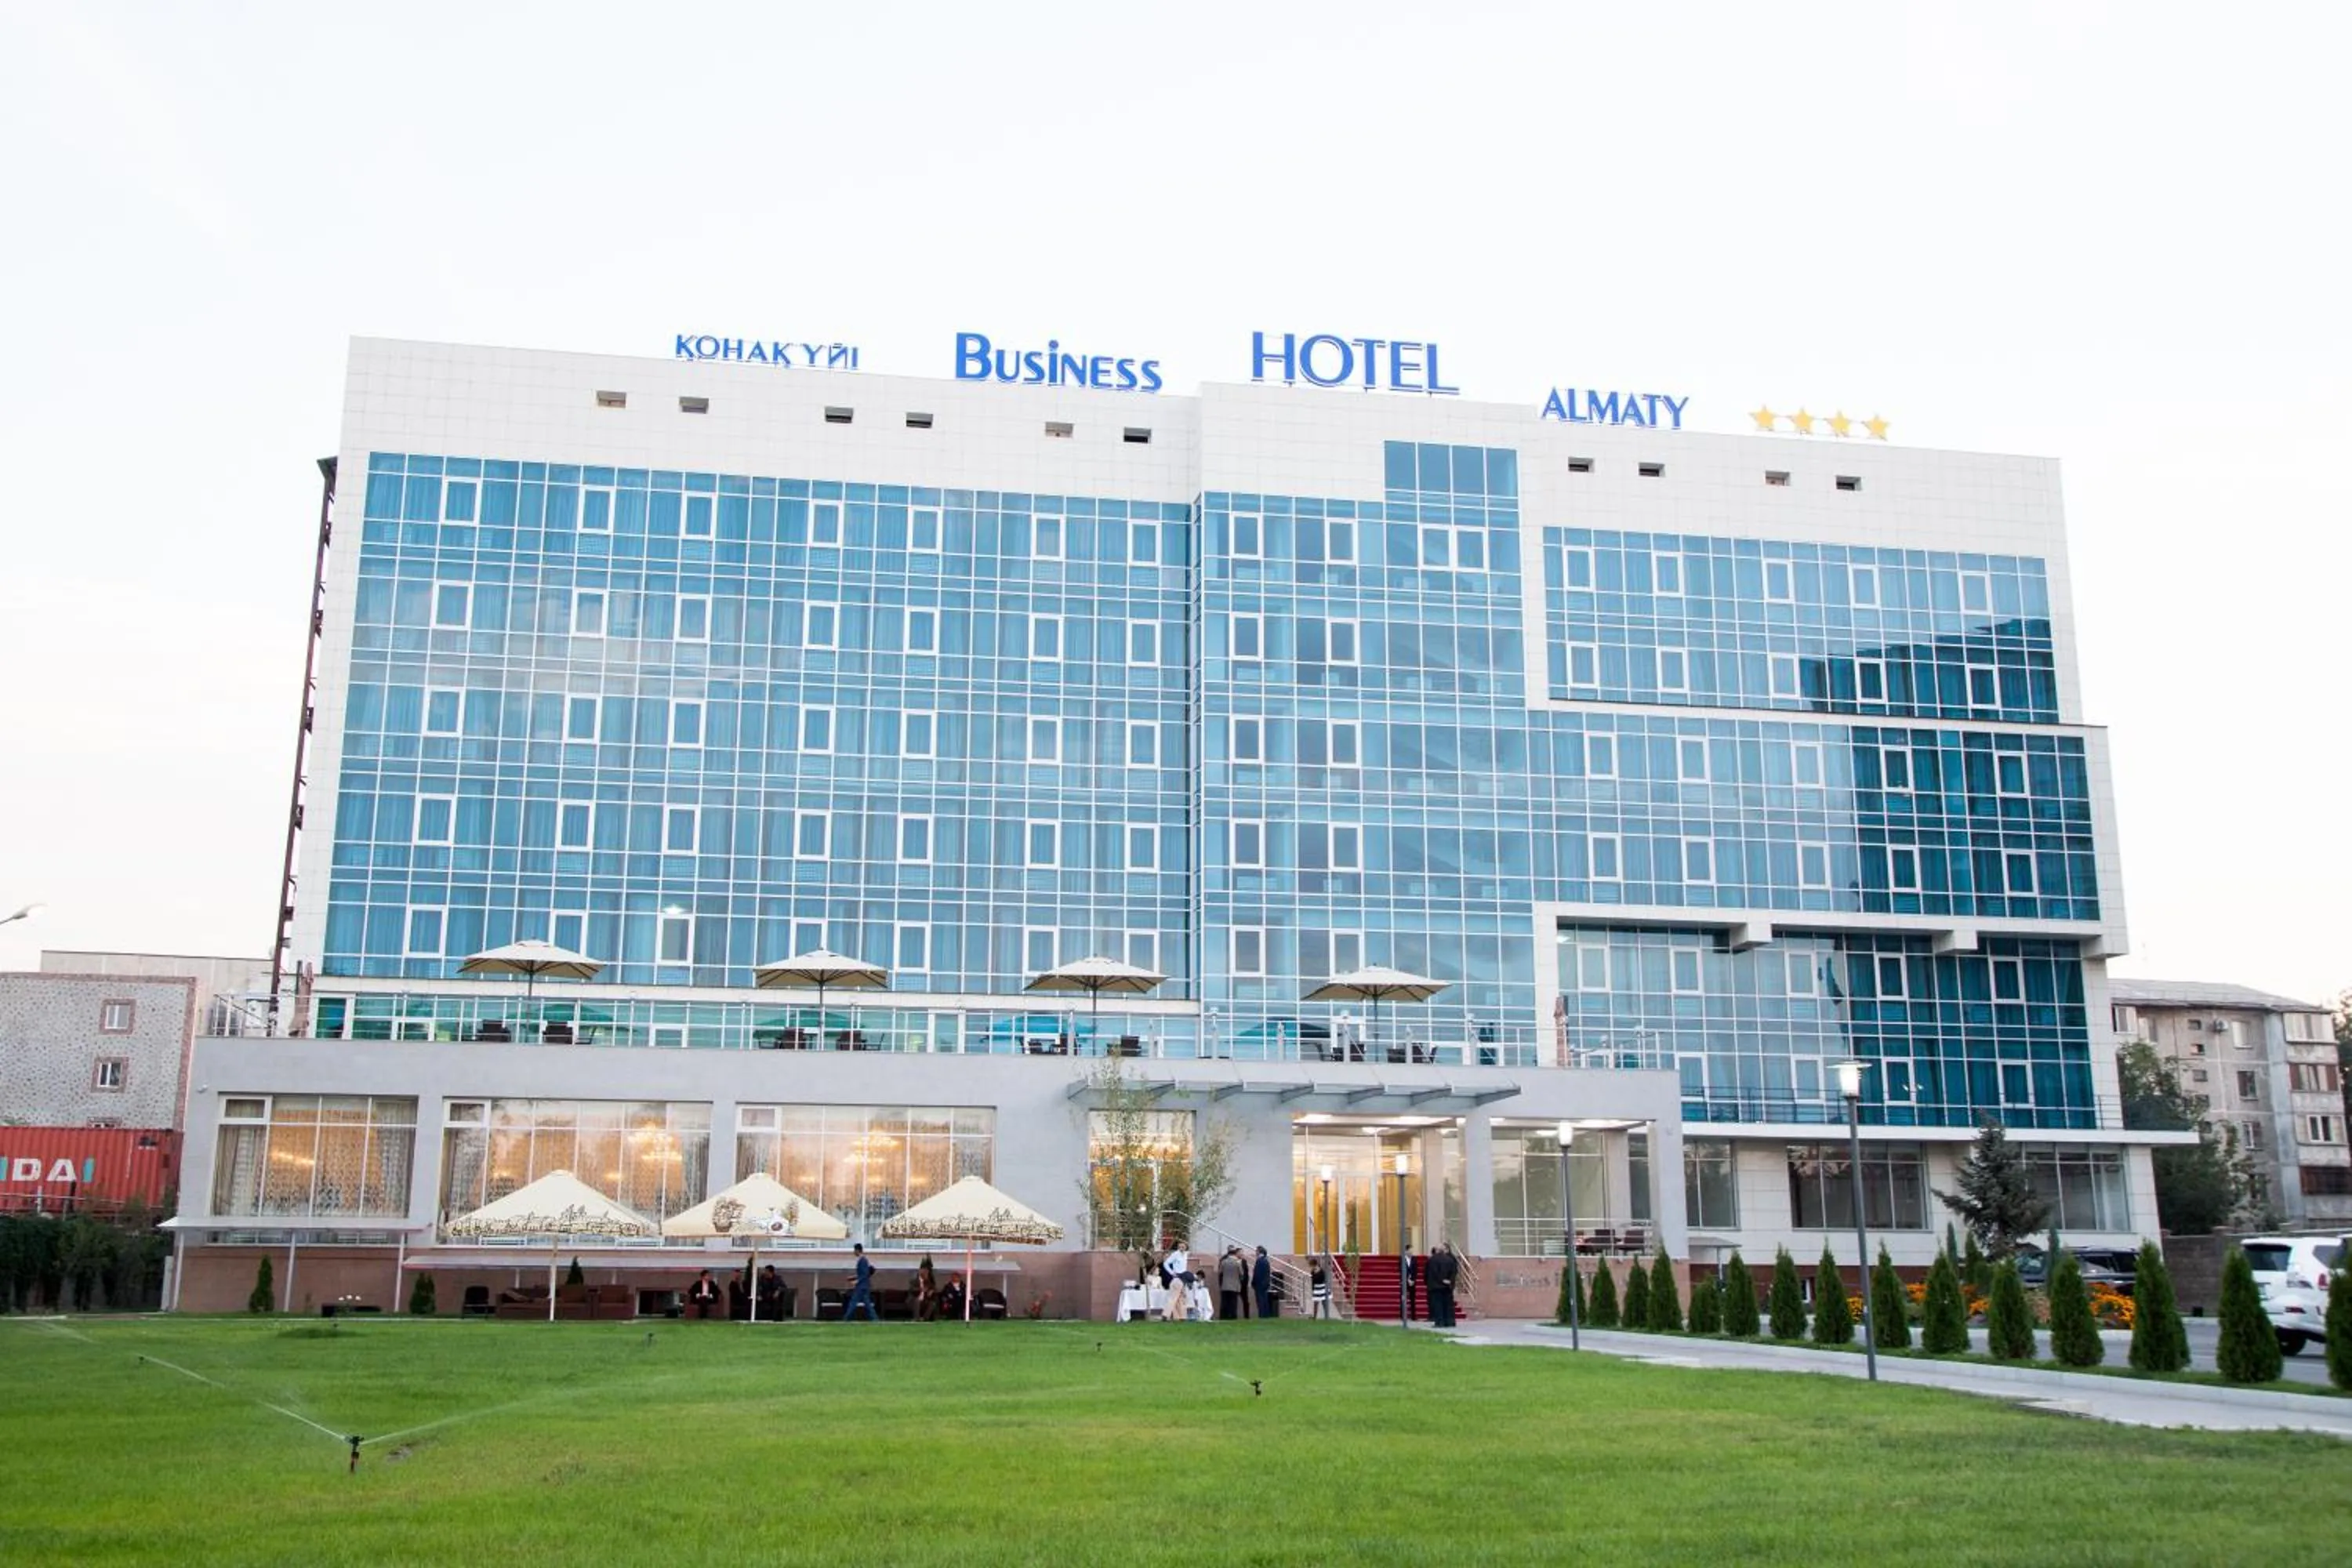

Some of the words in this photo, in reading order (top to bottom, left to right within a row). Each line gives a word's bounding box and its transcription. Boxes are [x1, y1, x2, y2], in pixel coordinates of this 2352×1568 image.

[1251, 331, 1460, 395] HOTEL
[1541, 387, 1689, 430] ALMATY
[0, 1155, 96, 1183] DAI
